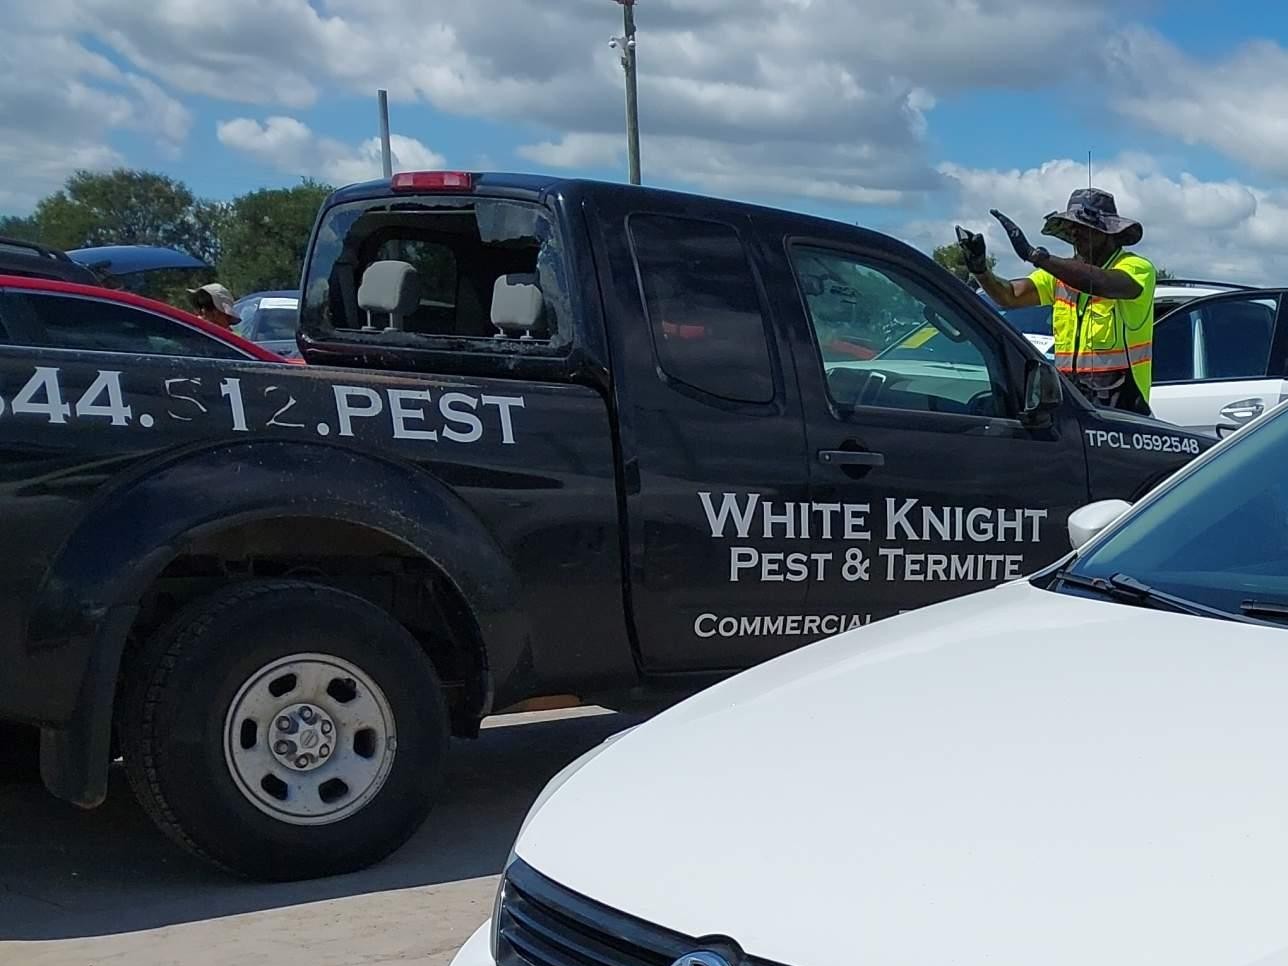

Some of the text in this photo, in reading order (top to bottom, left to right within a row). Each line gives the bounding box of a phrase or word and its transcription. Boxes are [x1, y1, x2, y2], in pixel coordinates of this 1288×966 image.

[1085, 429, 1200, 454] TPCL 0592548
[698, 491, 1048, 543] WHITE KNIGHT
[730, 546, 1024, 582] PEST & TERMITE
